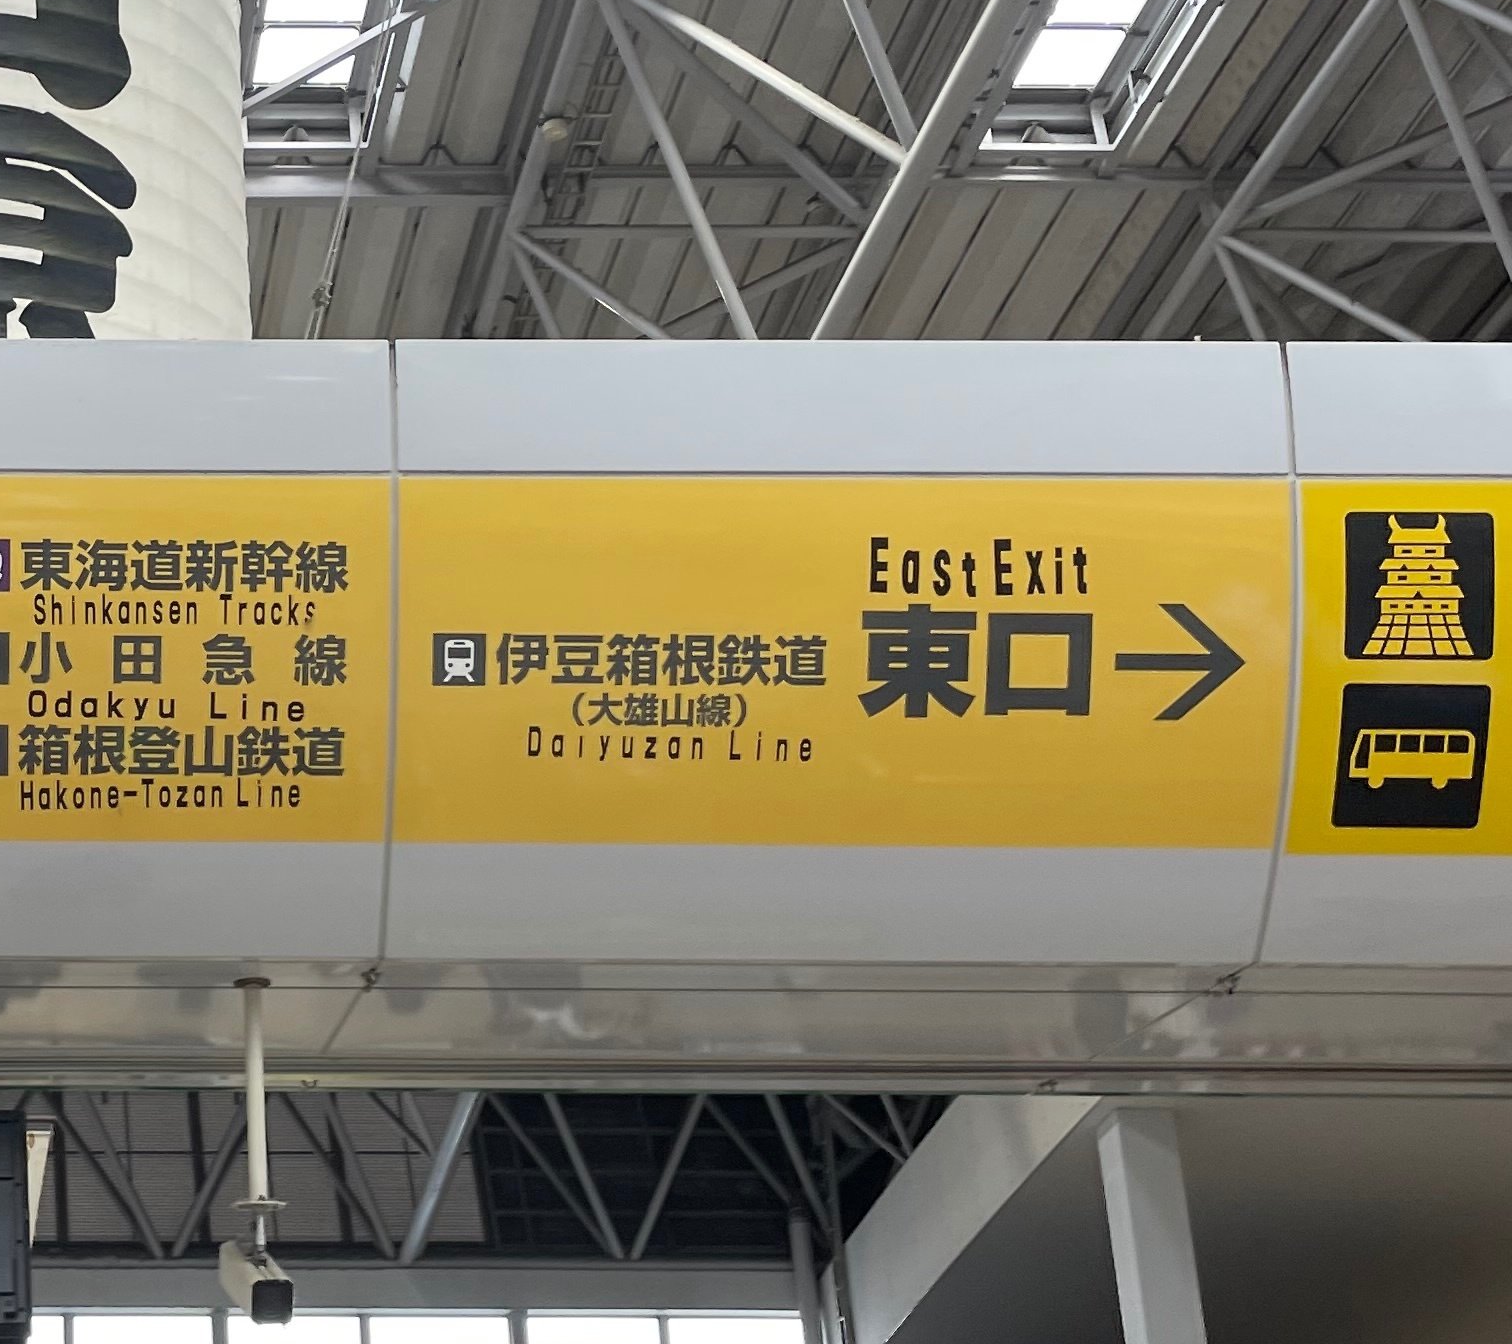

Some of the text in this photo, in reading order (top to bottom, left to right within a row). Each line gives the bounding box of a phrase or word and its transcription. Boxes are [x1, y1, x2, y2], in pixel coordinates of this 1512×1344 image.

[20, 538, 349, 593] 東海道新幹線
[32, 594, 317, 627] Shinkansen Tracks
[18, 632, 348, 687] 小田急線
[497, 632, 827, 687] 伊豆箱根鉄道
[858, 604, 1092, 719] 東口
[27, 690, 307, 723] Odakyu Line
[18, 724, 345, 778] 箱根登山鉄道
[728, 731, 812, 763] Line
[20, 779, 301, 810] Hakone-Tozan Line
